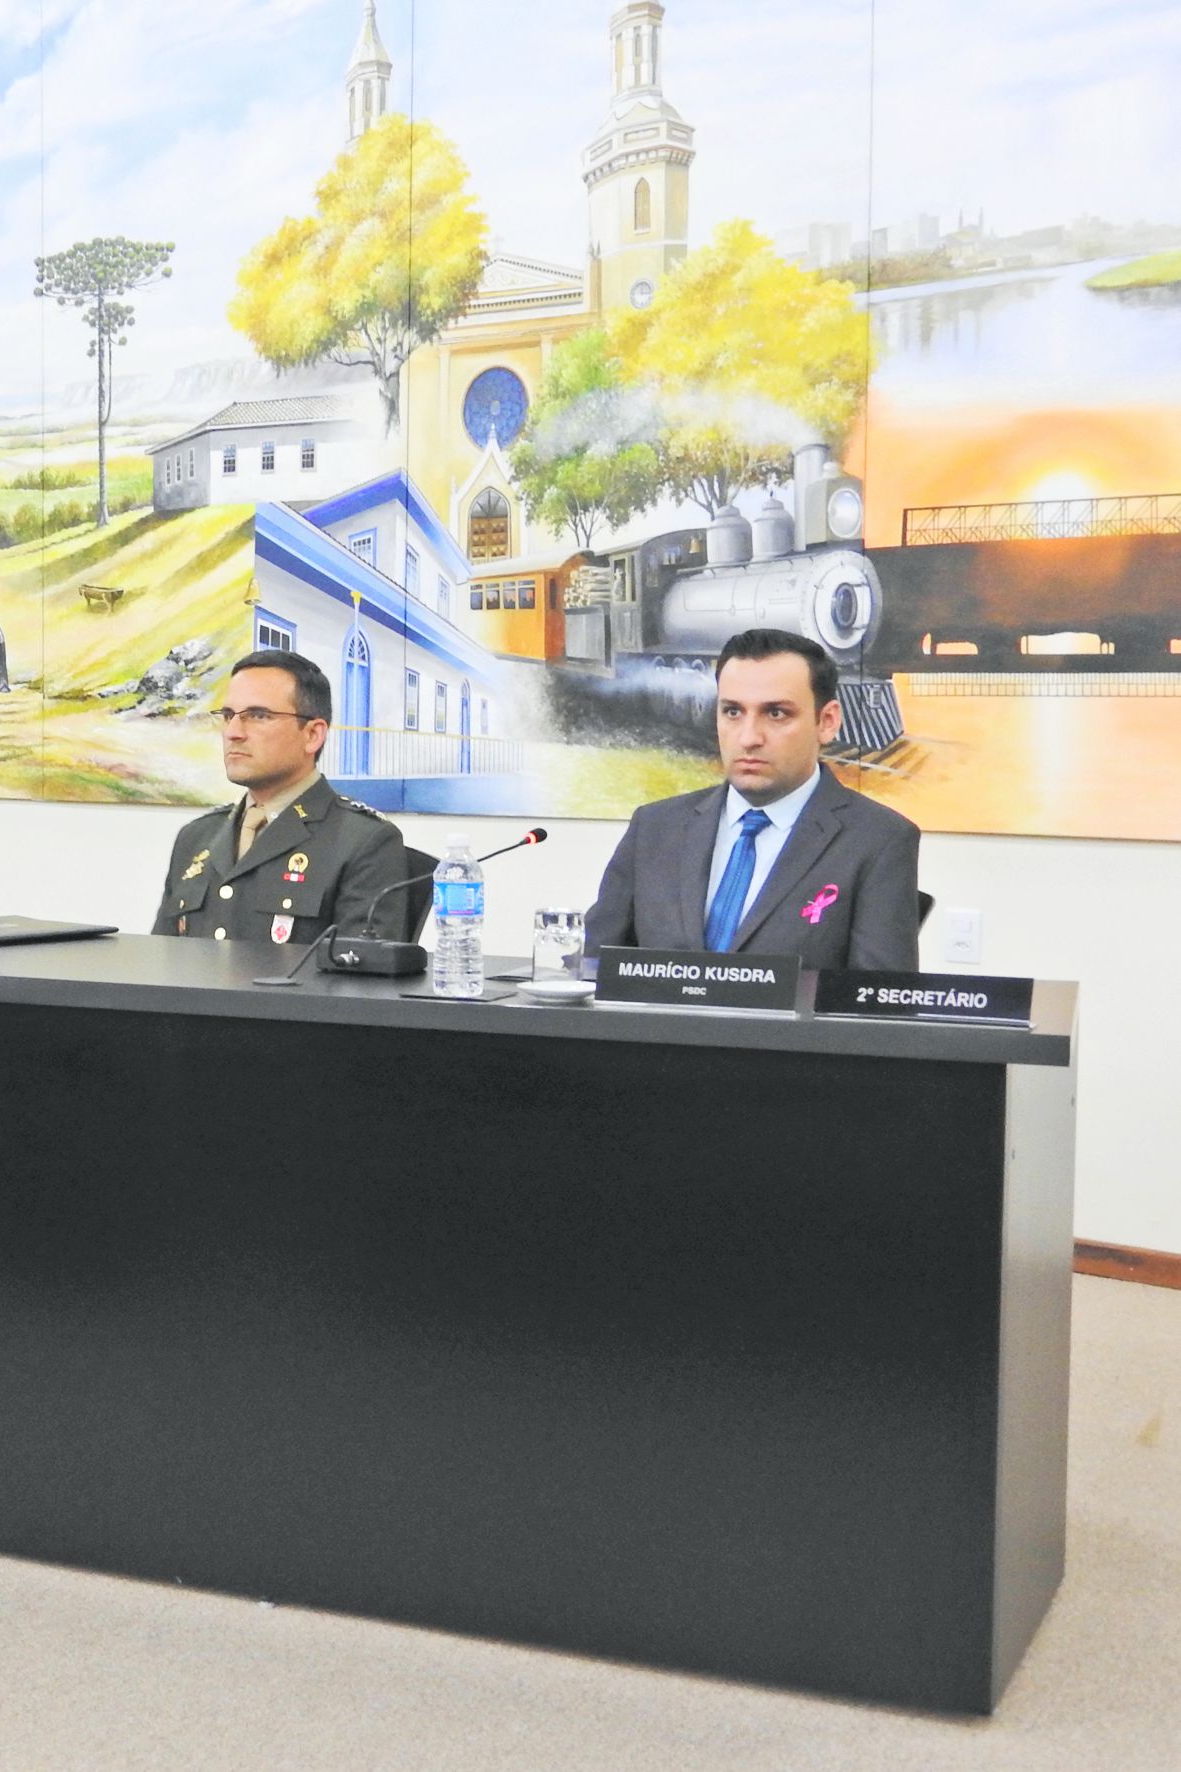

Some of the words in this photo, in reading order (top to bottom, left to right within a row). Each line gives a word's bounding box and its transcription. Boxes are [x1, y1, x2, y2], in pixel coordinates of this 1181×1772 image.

[618, 960, 701, 980] MAURÍCIO
[705, 965, 776, 983] KUSDRA
[682, 986, 707, 996] PSDC
[856, 987, 875, 1003] 2º
[877, 987, 988, 1009] SECRETÁRIO
